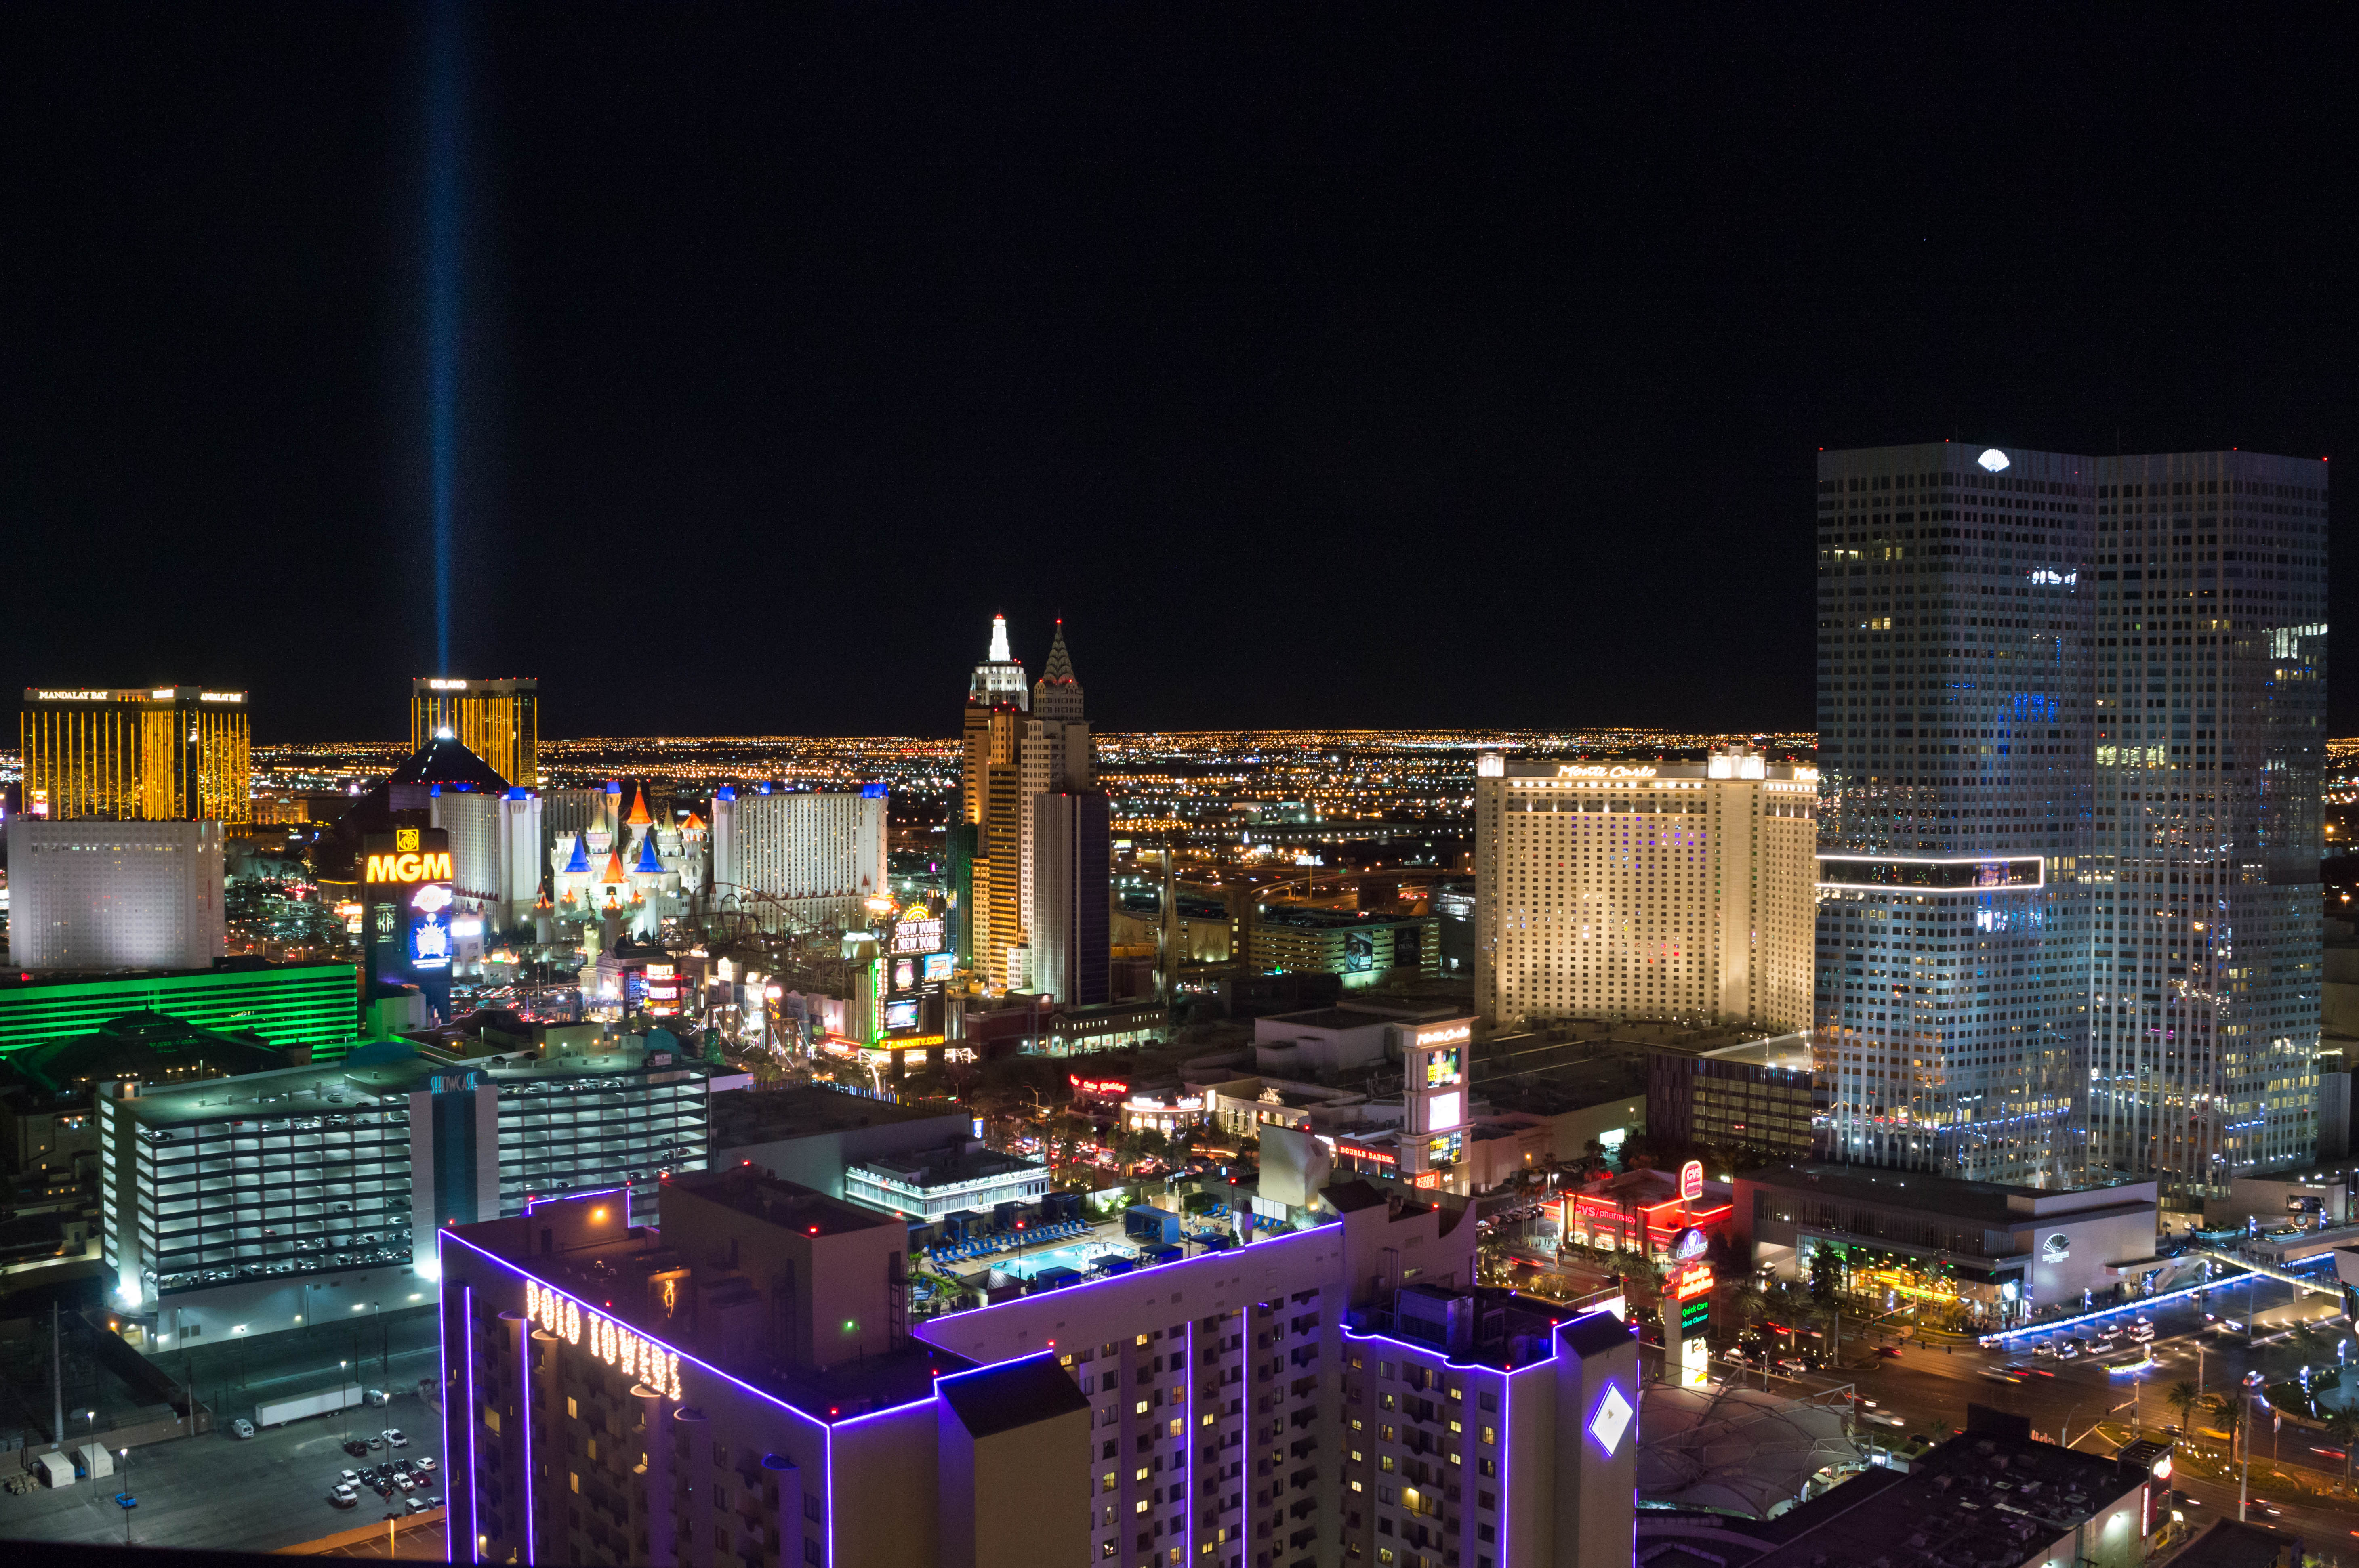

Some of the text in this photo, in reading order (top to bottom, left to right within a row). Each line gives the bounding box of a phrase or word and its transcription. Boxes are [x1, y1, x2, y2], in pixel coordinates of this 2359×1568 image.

[431, 680, 467, 689] DELANO
[1558, 766, 1657, 778] Monte Carlo
[366, 853, 452, 882] MGM
[898, 921, 941, 936] NEW YORK
[898, 935, 941, 950] NEW YORK
[629, 972, 640, 1009] HERSHEY'S
[430, 1072, 477, 1095] SHOWCASE
[1341, 1147, 1395, 1163] DOUBLE BARREL
[1013, 1168, 1044, 1179] WOLLENSKY
[1417, 1174, 1435, 1184] DOUBLE
[1686, 1167, 1701, 1180] CVS
[1417, 1180, 1435, 1188] BARREL
[1576, 1204, 1636, 1225] CVS/pharmacy
[1682, 1302, 1708, 1317] Quick Care
[1682, 1314, 1708, 1328] Shoe Cleaner
[527, 1279, 681, 1401] POLO TOWERS
